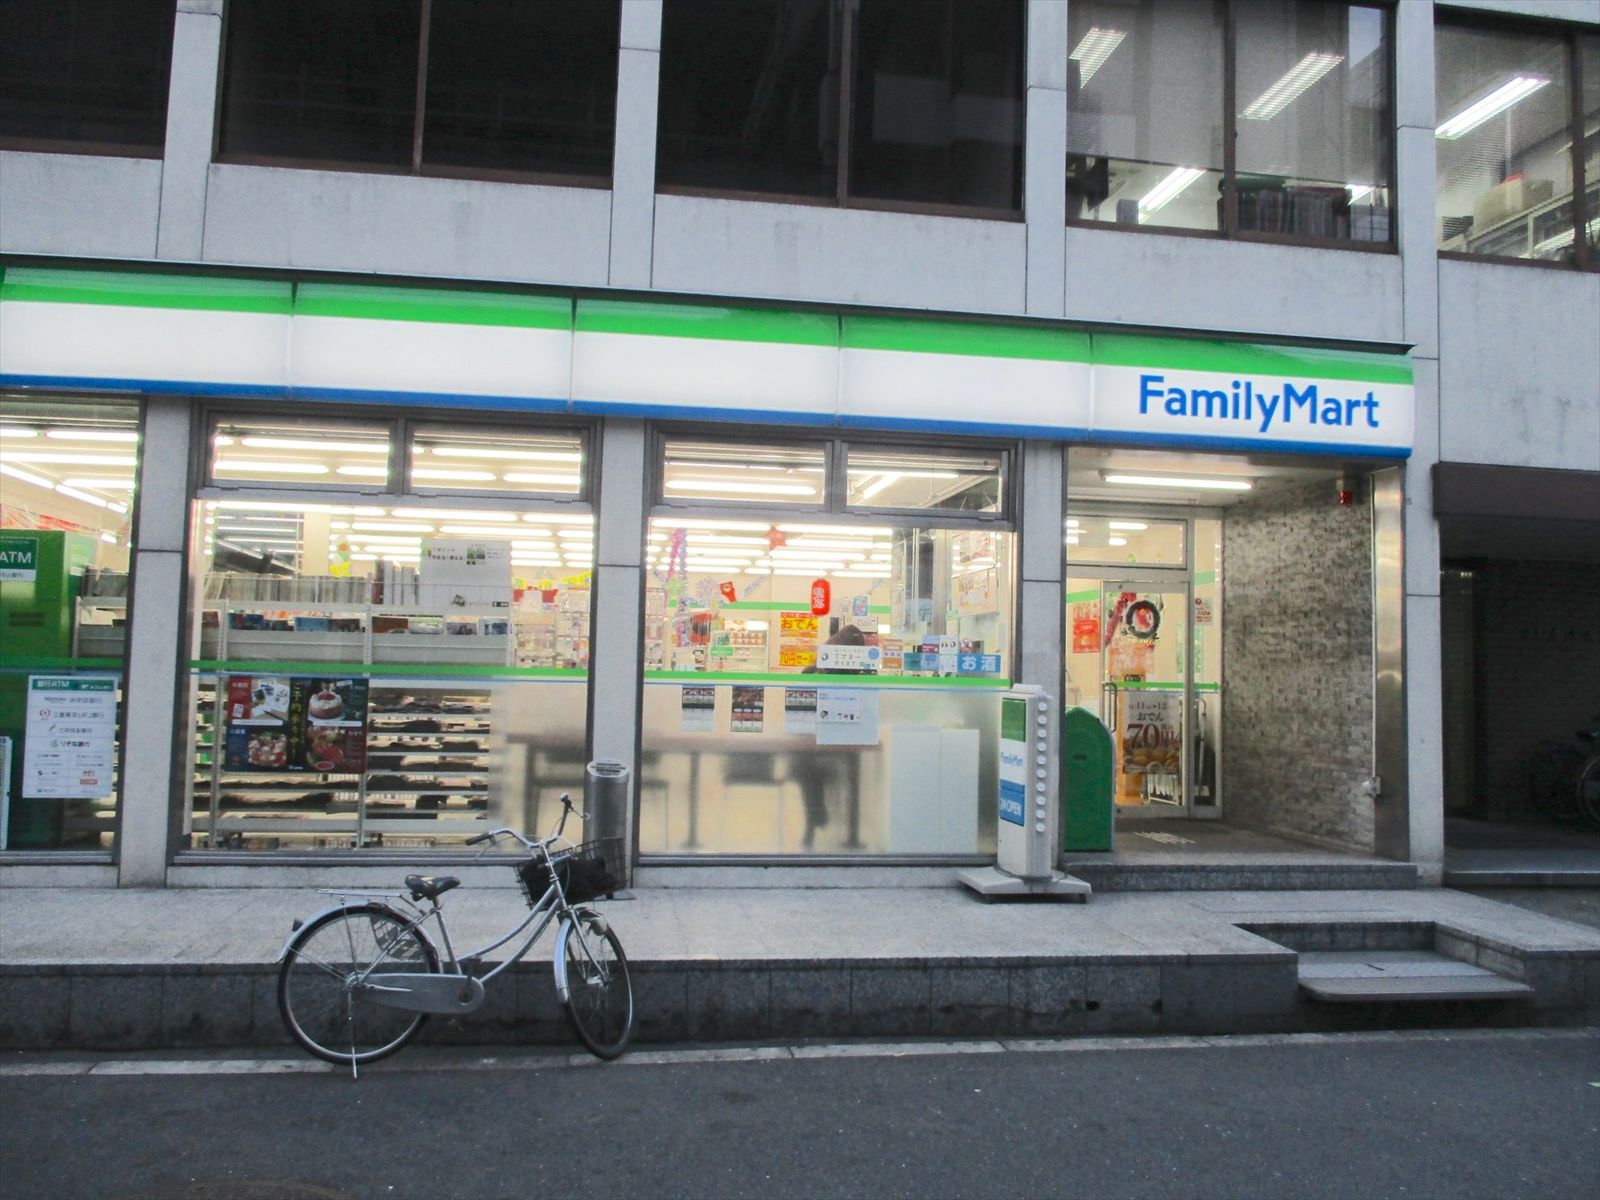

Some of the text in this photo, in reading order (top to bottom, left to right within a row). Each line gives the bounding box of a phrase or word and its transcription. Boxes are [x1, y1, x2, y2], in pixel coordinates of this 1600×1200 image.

[1139, 374, 1379, 432] FamilyMart
[0, 551, 32, 564] ATM
[961, 655, 997, 671] お酒
[1136, 711, 1165, 722] おでん
